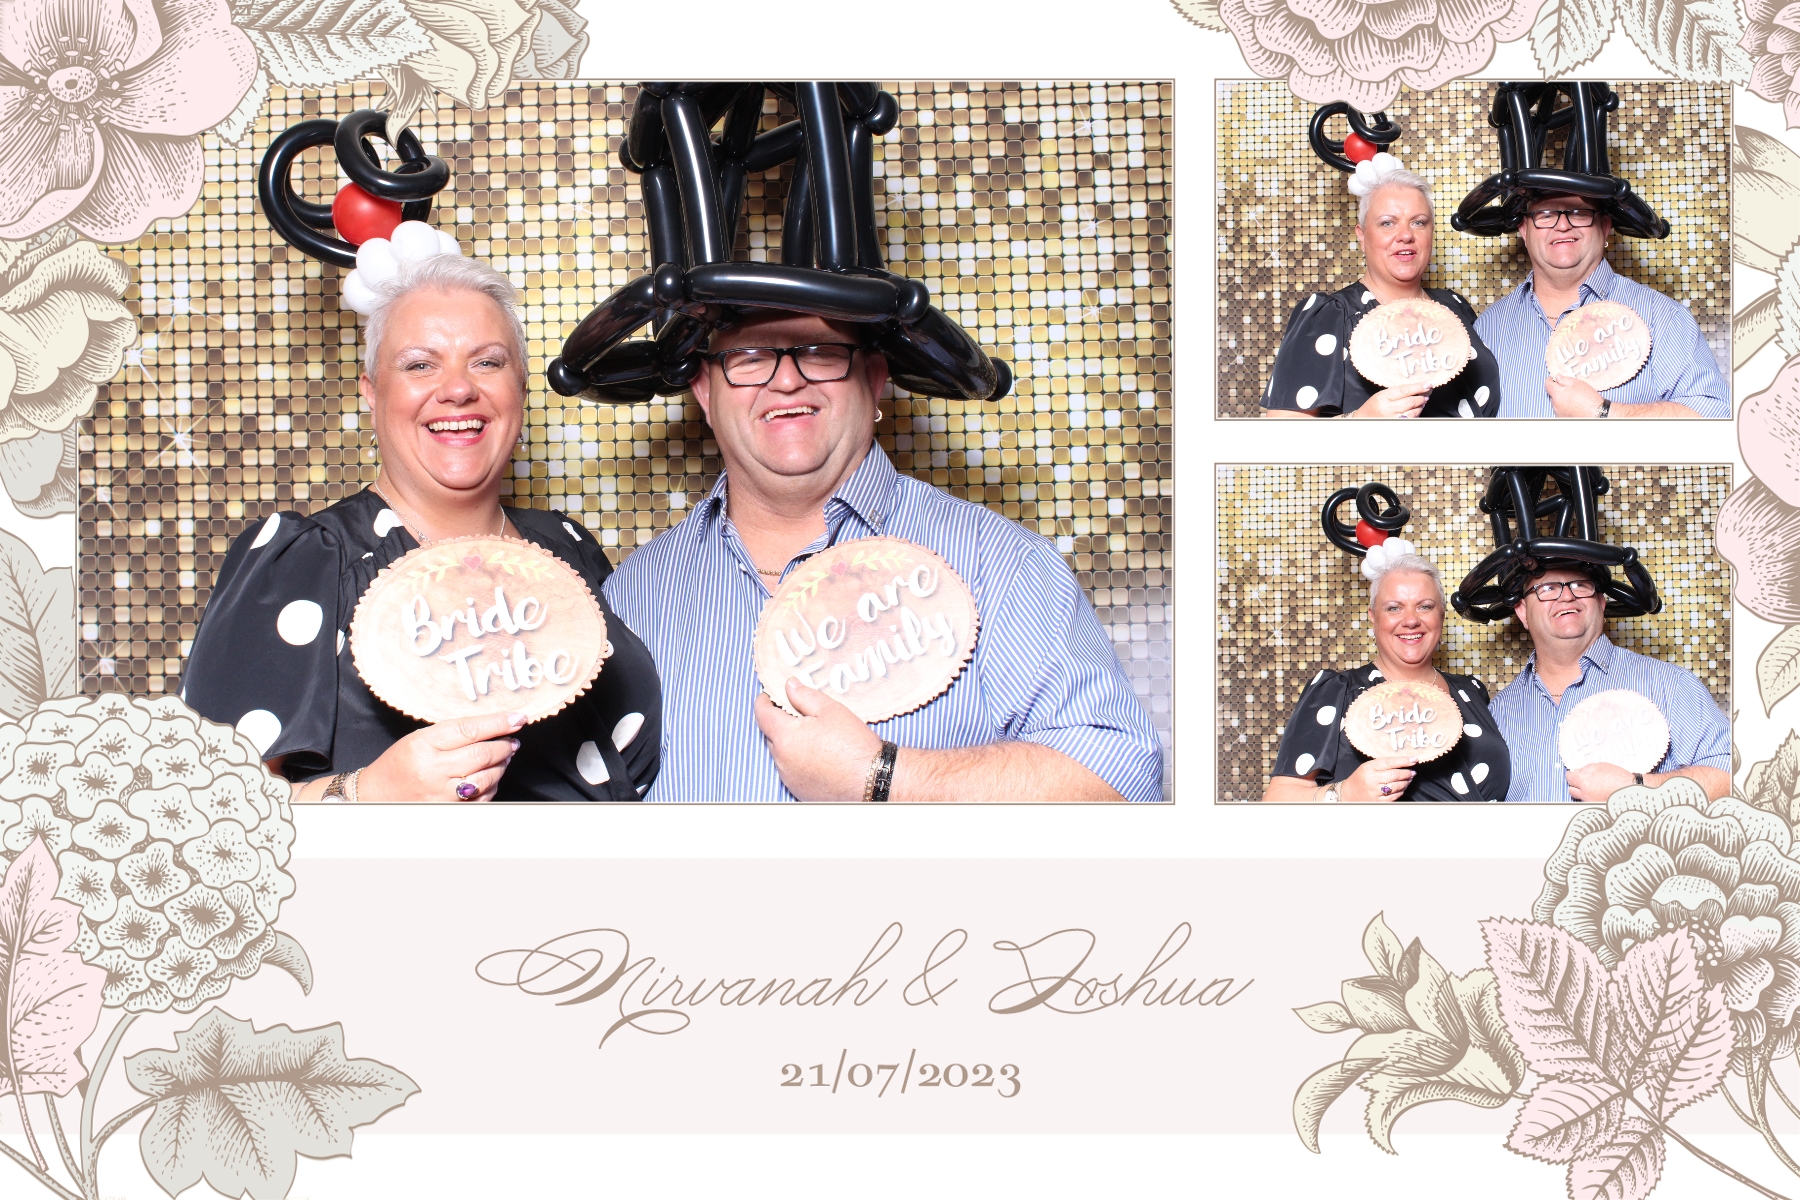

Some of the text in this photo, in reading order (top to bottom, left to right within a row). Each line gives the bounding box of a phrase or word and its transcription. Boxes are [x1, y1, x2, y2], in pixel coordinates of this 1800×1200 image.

[1374, 322, 1443, 356] Bride
[1556, 315, 1633, 364] We are
[1564, 335, 1641, 378] Family
[1391, 348, 1457, 378] Tribe
[401, 586, 548, 656] Bride
[775, 564, 938, 667] We are
[438, 640, 580, 701] Tribe
[794, 606, 956, 694] Family
[1369, 702, 1437, 730] Bride
[1384, 726, 1448, 751] Tribe
